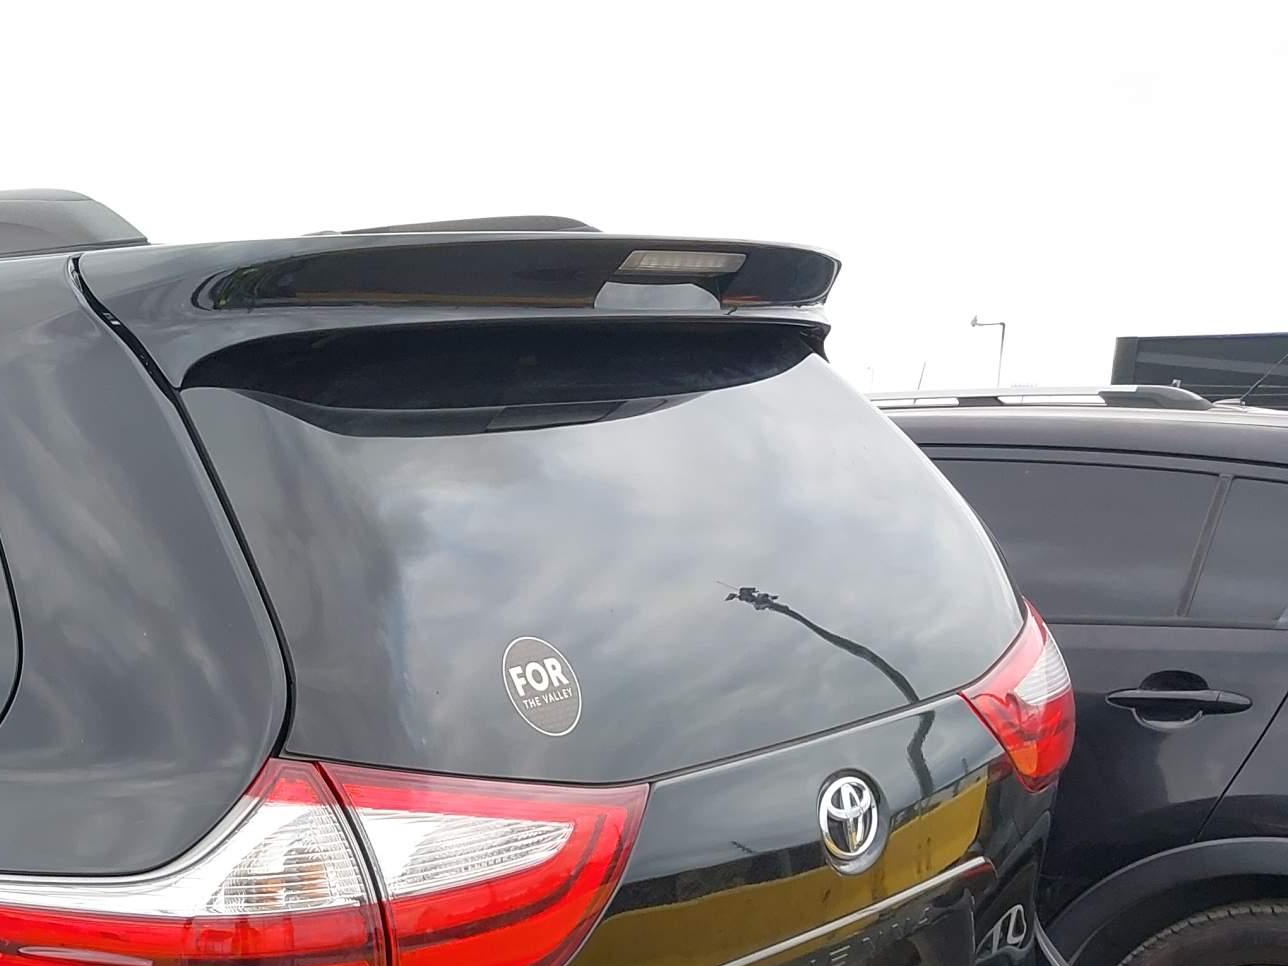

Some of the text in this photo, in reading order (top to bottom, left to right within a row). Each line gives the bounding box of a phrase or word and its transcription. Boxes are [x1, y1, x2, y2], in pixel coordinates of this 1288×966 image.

[508, 657, 570, 697] FOR
[522, 687, 573, 709] THE VALLEY
